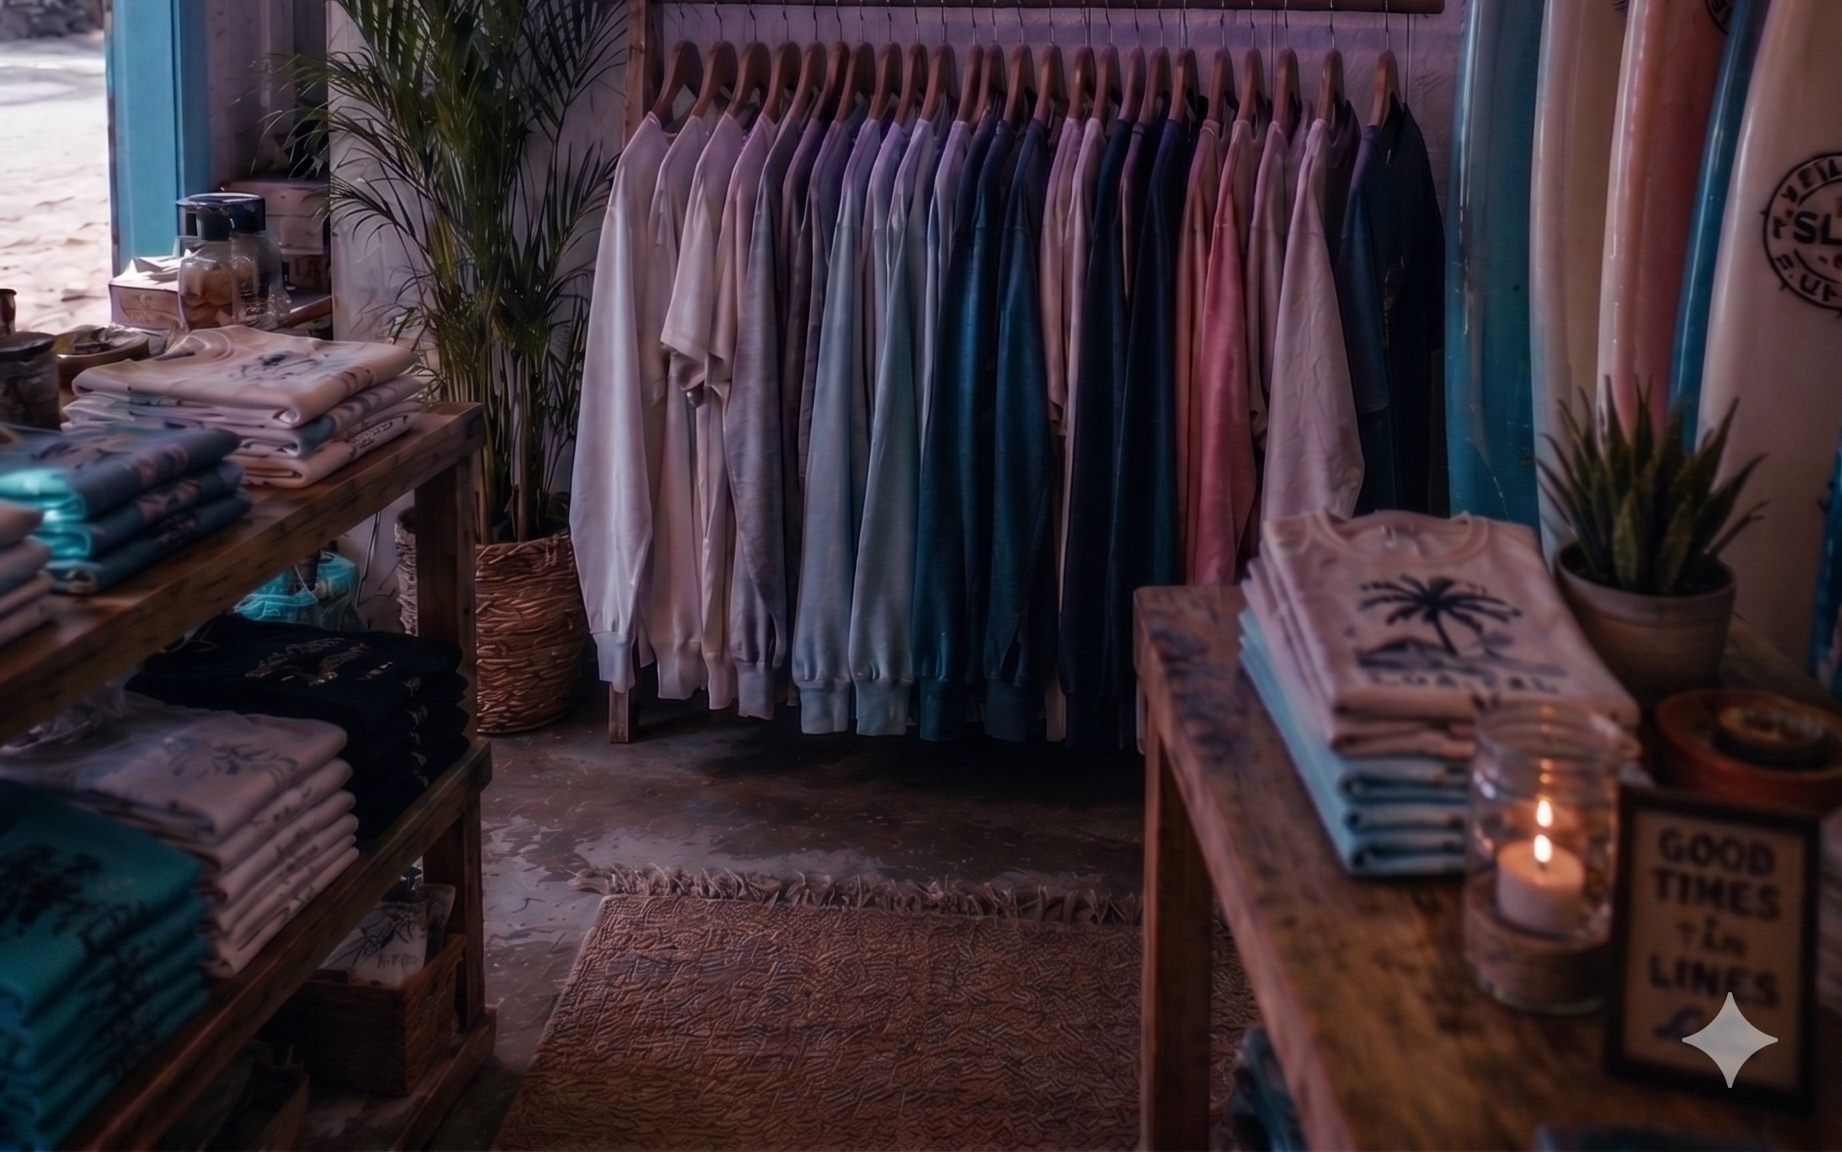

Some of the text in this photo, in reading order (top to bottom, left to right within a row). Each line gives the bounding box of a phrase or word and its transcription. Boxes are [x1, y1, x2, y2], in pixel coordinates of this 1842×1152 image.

[1657, 827, 1776, 876] GOOD
[1653, 868, 1781, 922] TIMES
[1648, 954, 1781, 1008] LINES
